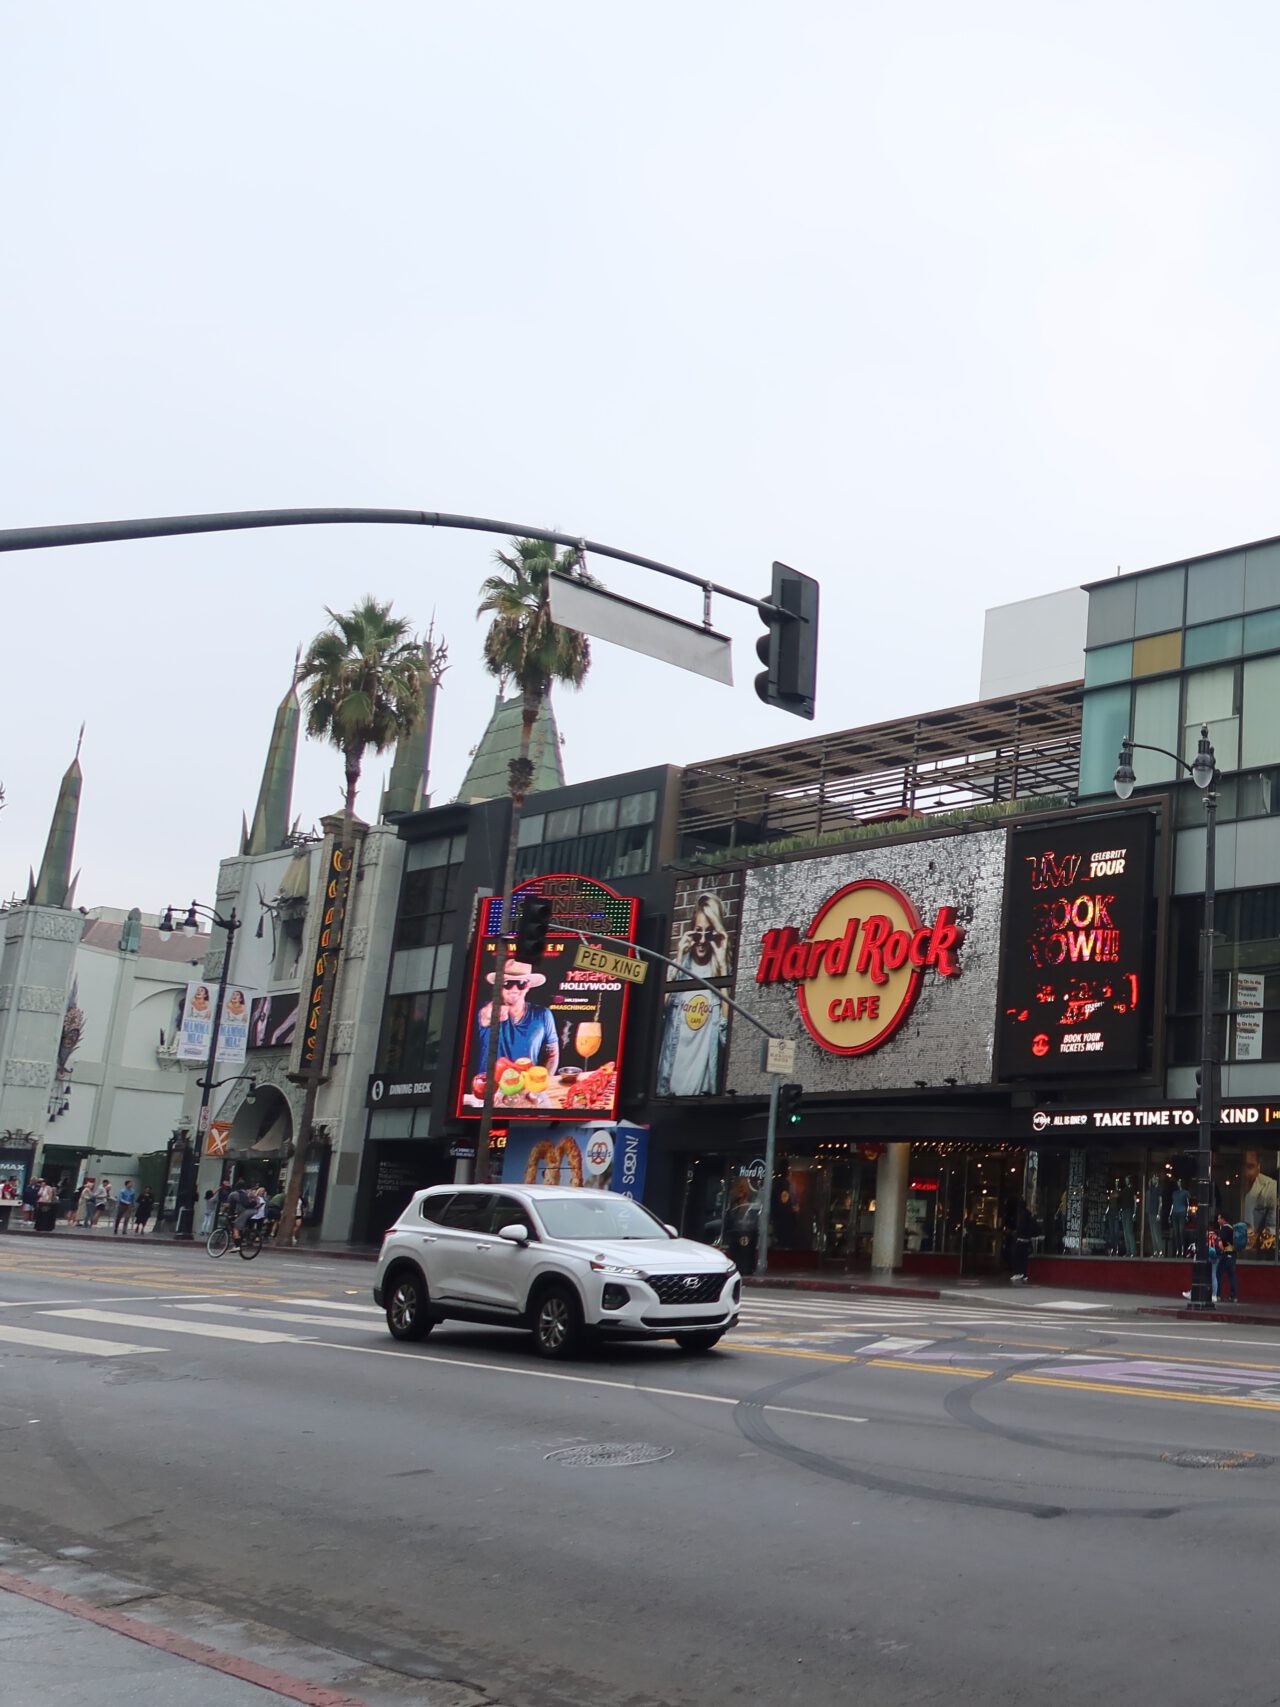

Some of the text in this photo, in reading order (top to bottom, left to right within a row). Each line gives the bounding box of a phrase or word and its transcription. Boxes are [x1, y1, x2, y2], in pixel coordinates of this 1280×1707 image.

[1090, 849, 1126, 861] CELEBRITY
[1090, 859, 1125, 878] TOUR
[543, 880, 581, 895] TCL
[516, 900, 606, 914] CNESE
[1034, 895, 1116, 930] OOK
[510, 916, 613, 933] TATRES
[756, 906, 966, 985] Hard Rock
[1034, 929, 1120, 967] OW!!!
[580, 950, 642, 978] PED XING
[560, 982, 622, 991] HOLLYWOOD
[827, 995, 880, 1022] CAFE
[1064, 1033, 1101, 1042] BOOK YOUR
[1060, 1042, 1104, 1053] TICKETS NOW!
[389, 1082, 432, 1095] DINING DECK
[1093, 1110, 1194, 1126] TAKE TIME TO
[1221, 1108, 1259, 1123] KIND
[739, 1165, 758, 1177] Hard
